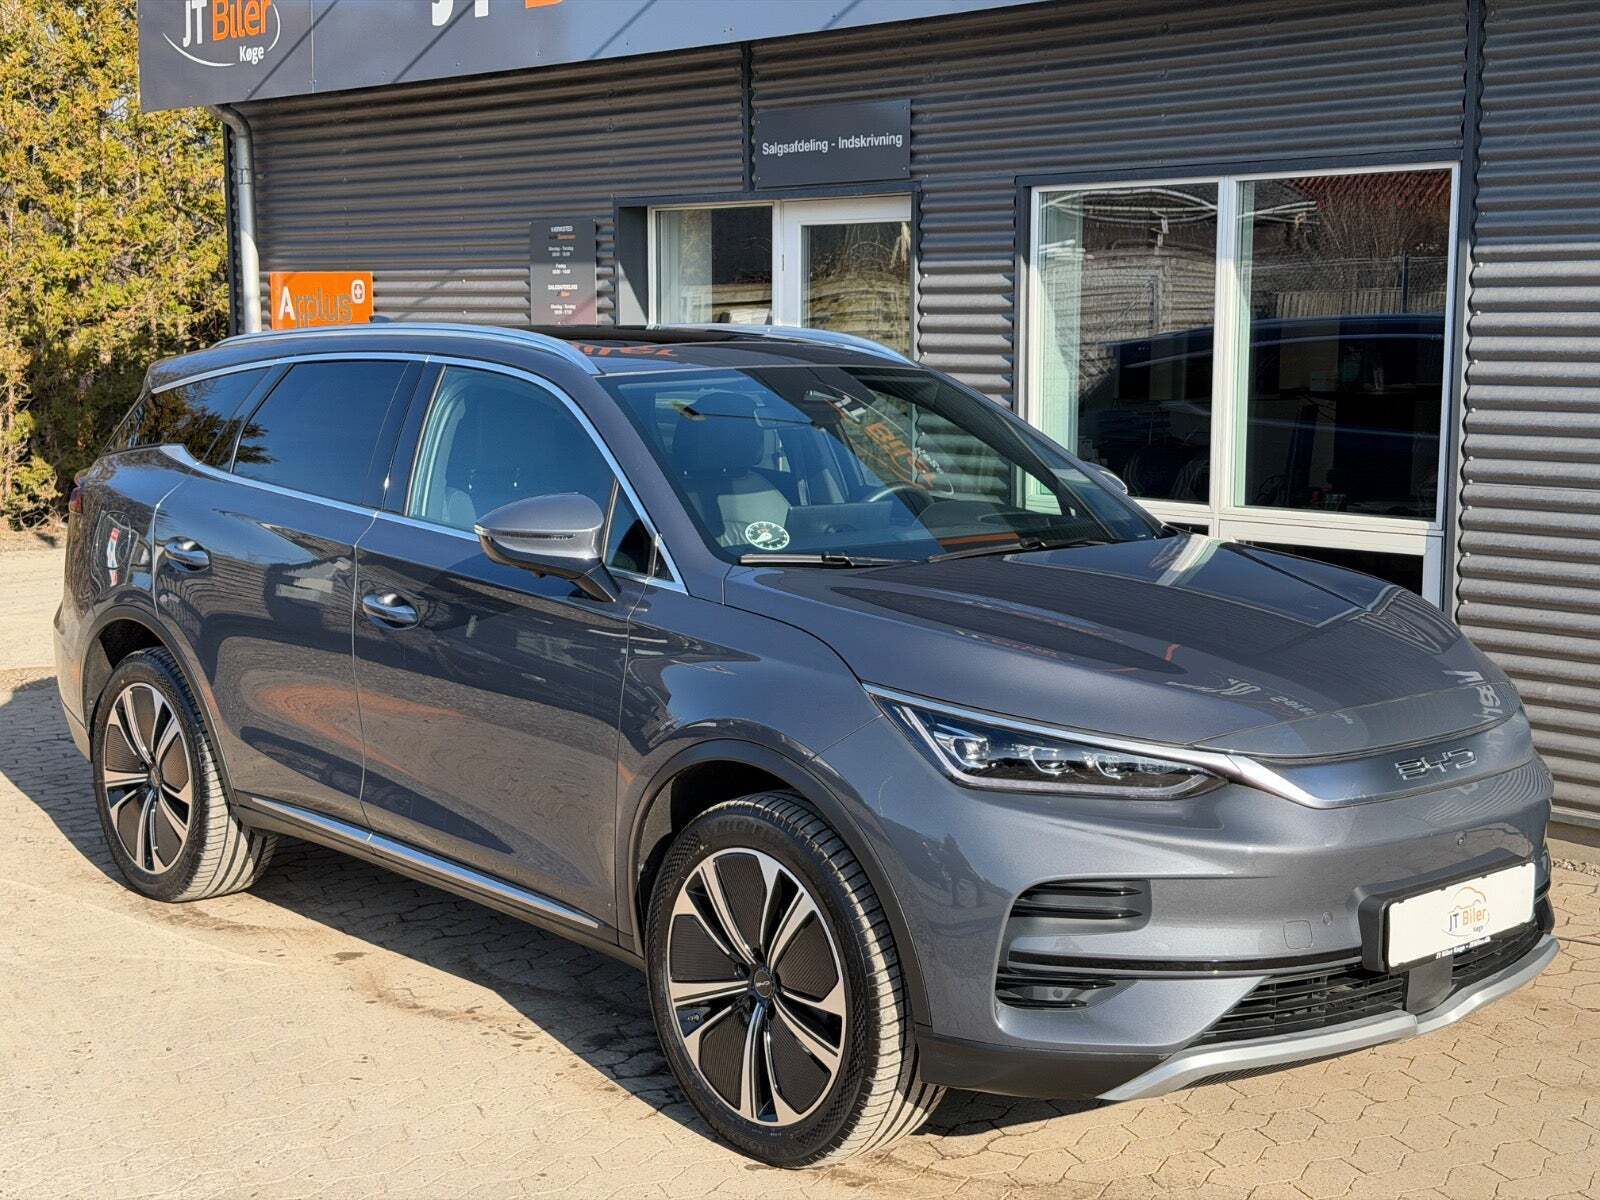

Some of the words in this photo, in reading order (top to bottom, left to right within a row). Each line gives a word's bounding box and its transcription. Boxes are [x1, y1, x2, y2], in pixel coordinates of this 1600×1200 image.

[182, 0, 207, 48] JT
[212, 0, 272, 41] Biler
[239, 45, 265, 65] Køge
[761, 138, 829, 157] Salgsafdeling
[838, 132, 903, 149] Indskrivning
[1394, 747, 1478, 781] BYD
[1448, 912, 1460, 932] JT
[1462, 908, 1487, 926] Biler
